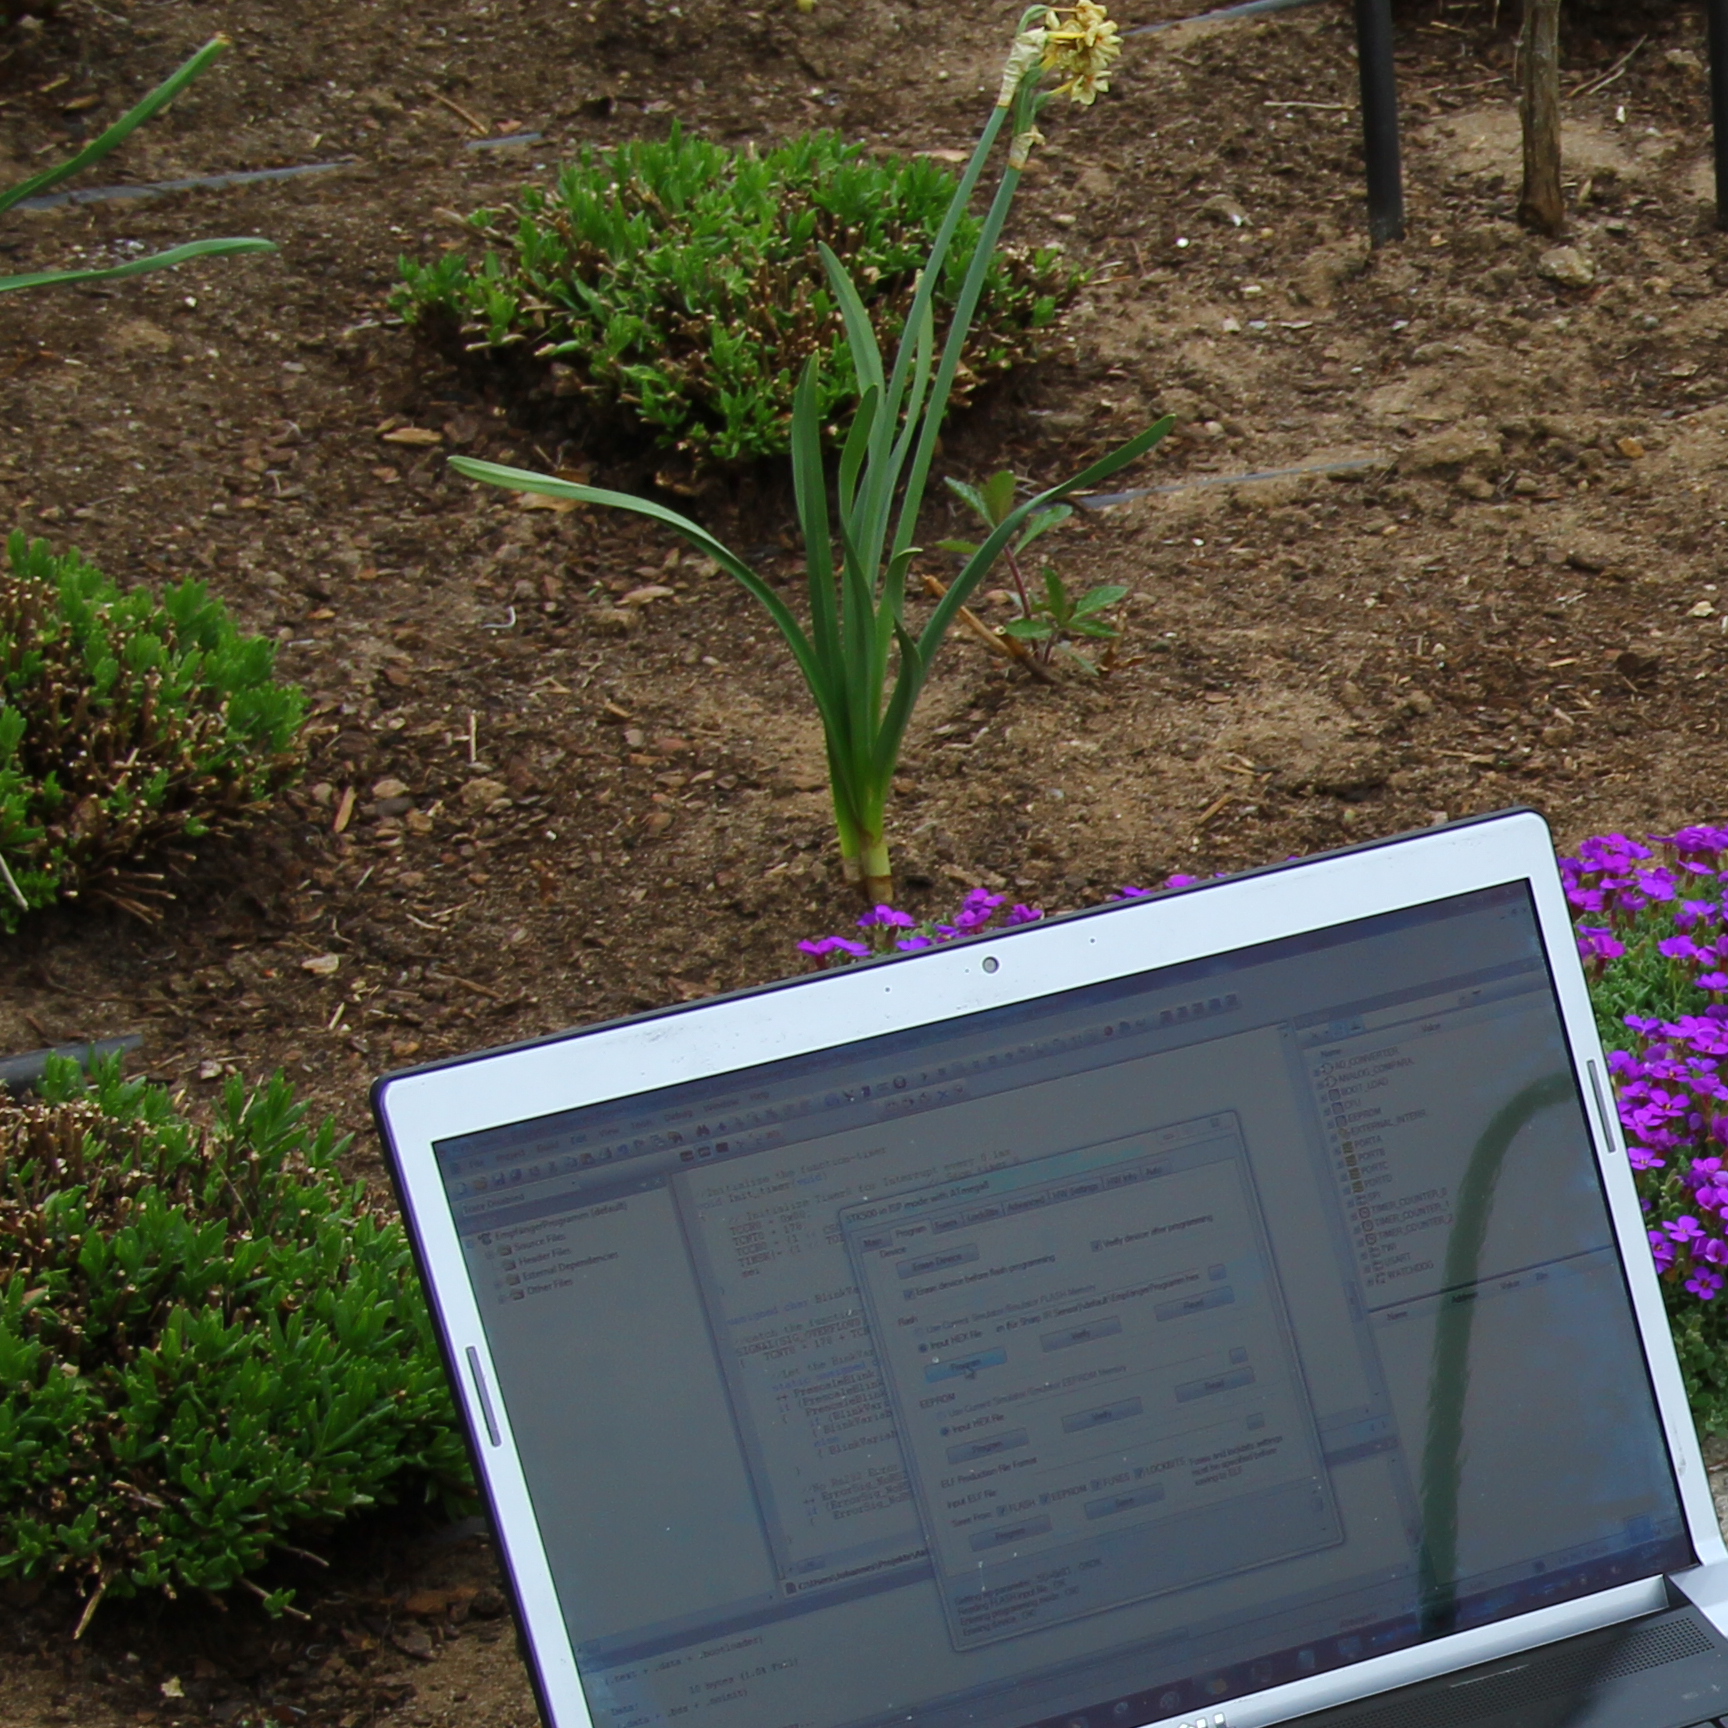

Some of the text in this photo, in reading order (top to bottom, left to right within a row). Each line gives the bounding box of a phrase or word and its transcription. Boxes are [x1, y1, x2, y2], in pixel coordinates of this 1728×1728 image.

[515, 1233, 565, 1249] Source Files
[520, 1248, 571, 1264] Header Files
[524, 1253, 619, 1279] External Dependencies
[528, 1279, 572, 1293] Other Files
